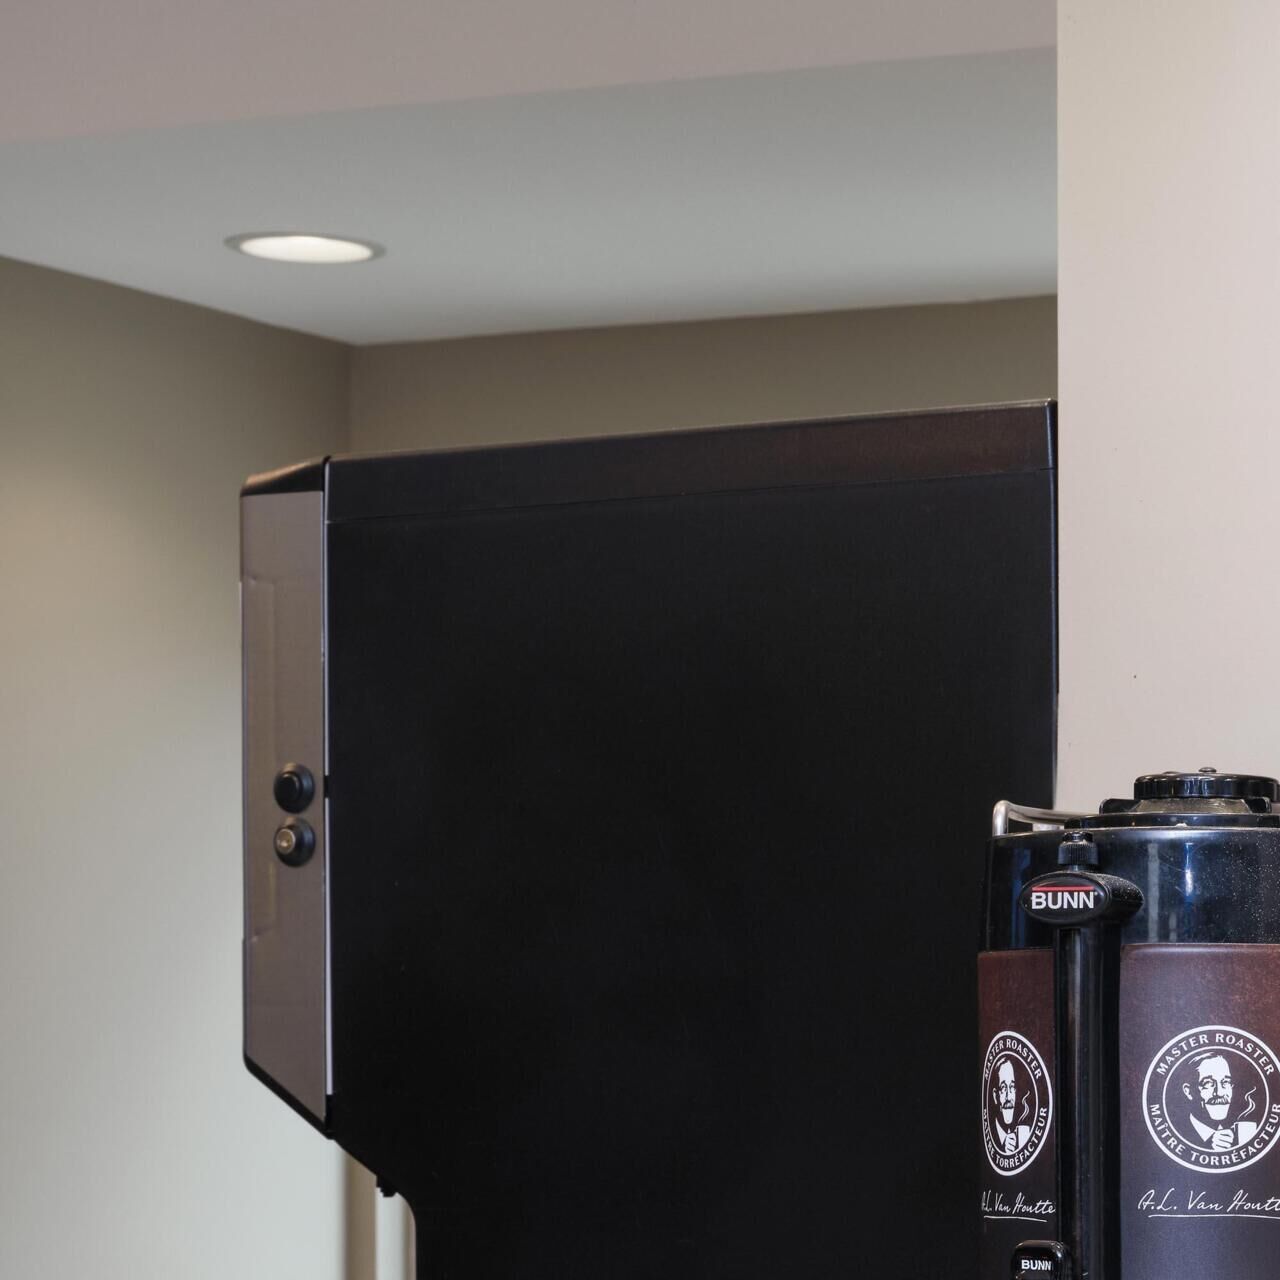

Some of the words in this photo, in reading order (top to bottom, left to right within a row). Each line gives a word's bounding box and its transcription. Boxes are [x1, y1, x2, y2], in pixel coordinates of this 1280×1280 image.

[1031, 892, 1095, 910] BUNN
[1157, 1033, 1210, 1076] MASTER
[1215, 1033, 1275, 1076] ROASTER
[1150, 1103, 1185, 1157] MAÎTRE
[1187, 1190, 1224, 1210] Van
